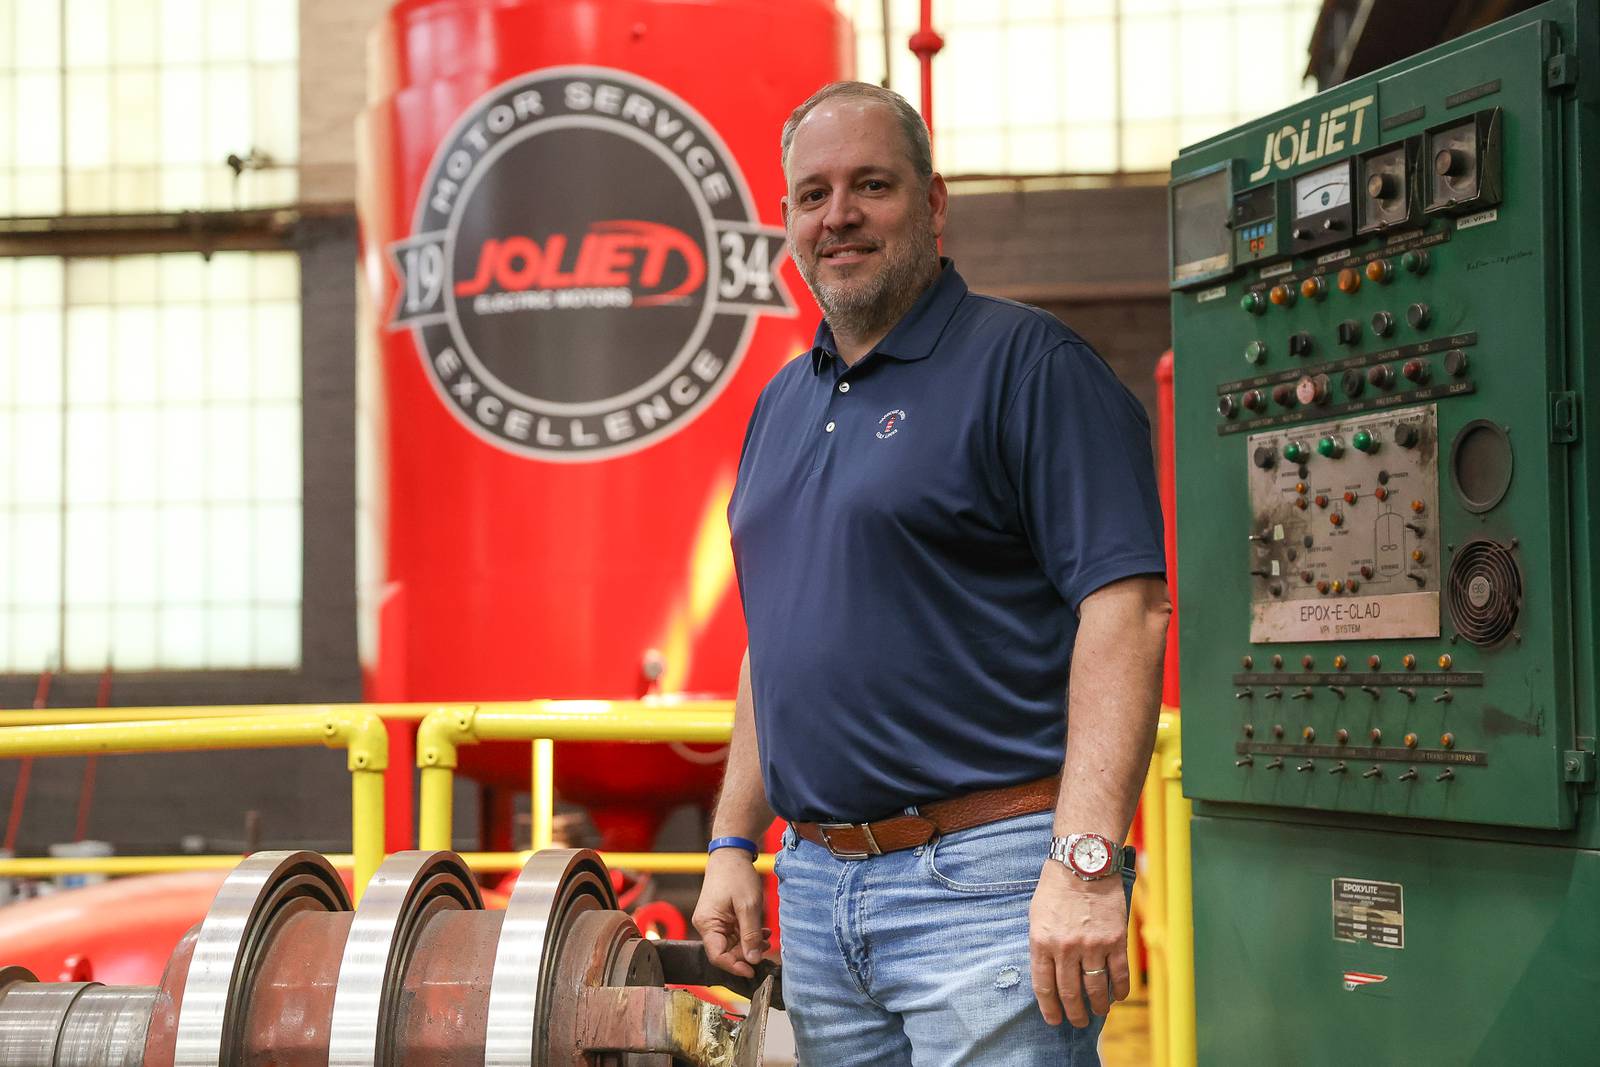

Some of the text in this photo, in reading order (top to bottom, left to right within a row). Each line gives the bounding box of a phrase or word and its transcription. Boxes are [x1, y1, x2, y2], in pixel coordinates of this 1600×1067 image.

[431, 82, 732, 214] MOTOR SERVICE
[1250, 96, 1374, 182] JOLIET
[404, 243, 445, 311] 19
[454, 226, 685, 297] JOLIET
[719, 231, 773, 300] 34
[555, 287, 633, 309] MOTORS
[435, 346, 723, 447] EXCELLENCE
[1300, 602, 1381, 622] EPOX-E-CLAD
[1320, 624, 1361, 634] VPI SYSTEM
[1343, 882, 1378, 895] EPOXYLITE
